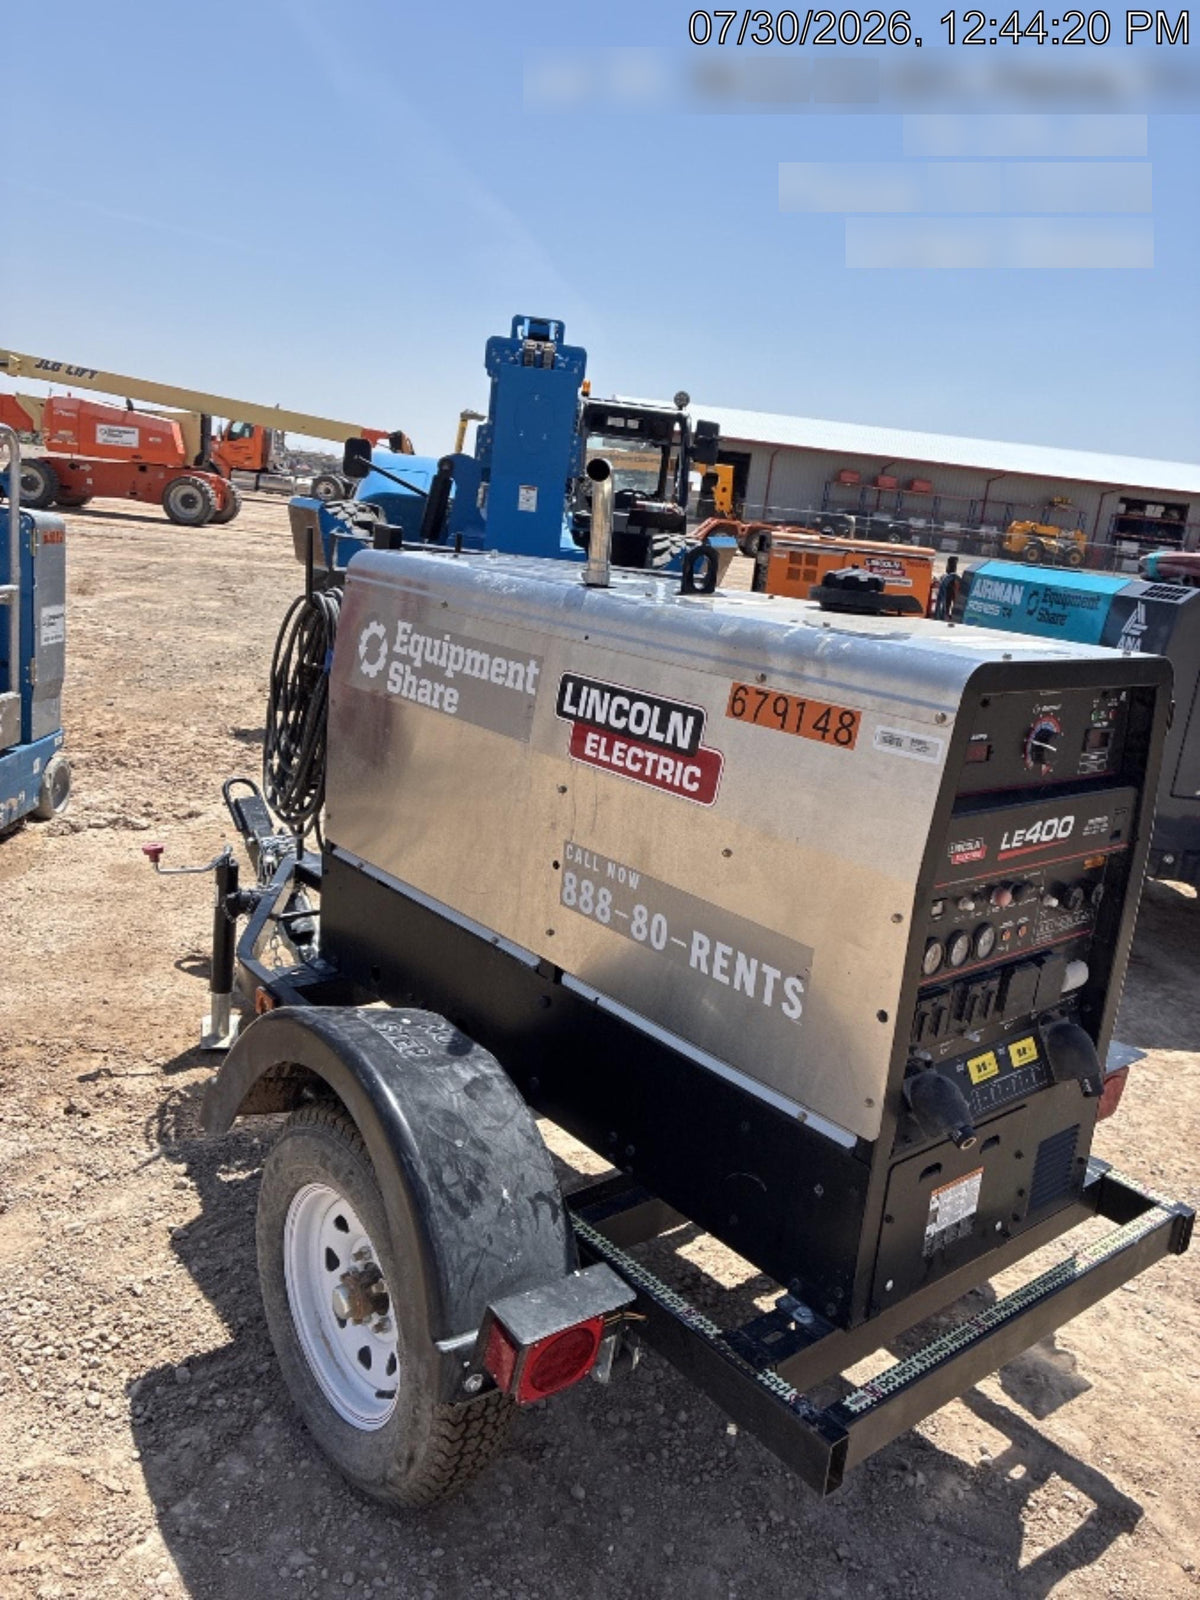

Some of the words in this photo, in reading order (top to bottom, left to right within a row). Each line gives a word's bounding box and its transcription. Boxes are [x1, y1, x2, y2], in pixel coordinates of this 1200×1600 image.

[65, 366, 98, 380] LIFT
[972, 579, 1025, 605] AIRMAN
[1041, 588, 1101, 611] Equipment
[1036, 606, 1068, 627] Share
[392, 619, 540, 697] Equipment
[1116, 635, 1143, 651] ANA
[386, 660, 460, 714] Share
[562, 681, 695, 750] LINCOLN
[730, 685, 856, 746] 679148
[584, 731, 702, 792] ELECTRIC
[1000, 815, 1075, 850] LE400
[565, 843, 600, 872] CALL
[606, 862, 641, 890] NOW
[561, 871, 804, 1021] 888-80-RENTS
[879, 1375, 896, 1390] DO
[895, 1360, 917, 1378] NOT
[915, 1340, 949, 1364] STAND
